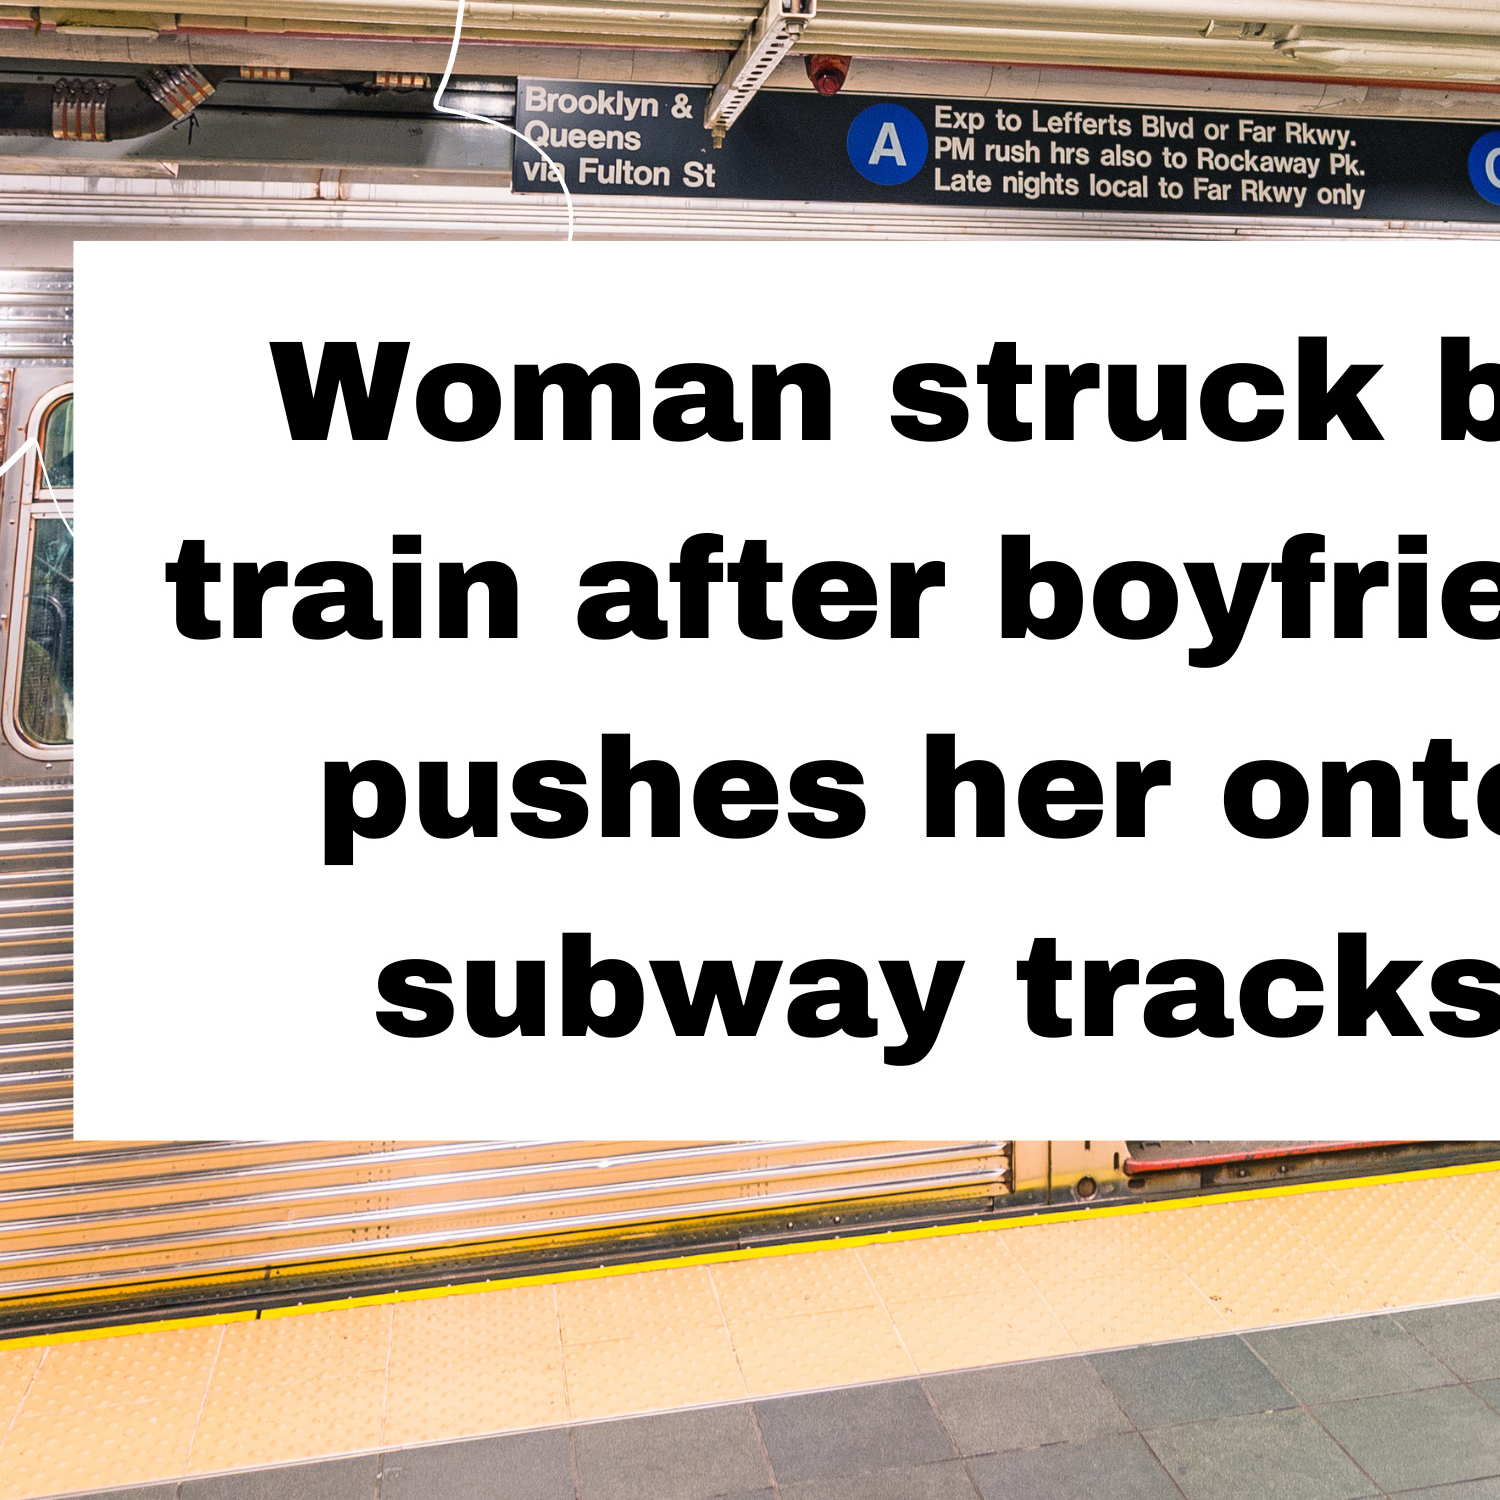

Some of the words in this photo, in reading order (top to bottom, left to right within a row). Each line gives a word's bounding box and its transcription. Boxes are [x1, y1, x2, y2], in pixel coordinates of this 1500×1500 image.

[524, 86, 660, 121] Brooklyn
[671, 93, 694, 118] &
[524, 120, 642, 152] Queens
[869, 122, 907, 167] A
[935, 104, 985, 135] Exp
[996, 108, 1022, 132] to
[1033, 110, 1134, 138] Lefferts
[1141, 114, 1195, 140] Blvd
[1203, 123, 1230, 141] or
[1238, 119, 1277, 143] Far
[1285, 121, 1356, 150] Rkwy.
[523, 156, 566, 183] via
[579, 156, 671, 187] Fulton
[683, 160, 716, 188] St
[934, 135, 975, 161] PM
[986, 139, 1040, 164] rush
[1050, 140, 1090, 166] hrs
[1100, 143, 1152, 168] also
[1161, 146, 1188, 170] to
[1198, 147, 1321, 178] Rockaway
[1329, 152, 1366, 177] Pk.
[934, 168, 992, 193] Late
[1003, 171, 1080, 200] nights
[1089, 173, 1149, 198] local
[1157, 176, 1184, 200] to
[1193, 177, 1232, 201] Far
[1241, 179, 1308, 208] Rkwy
[1316, 183, 1366, 211] only
